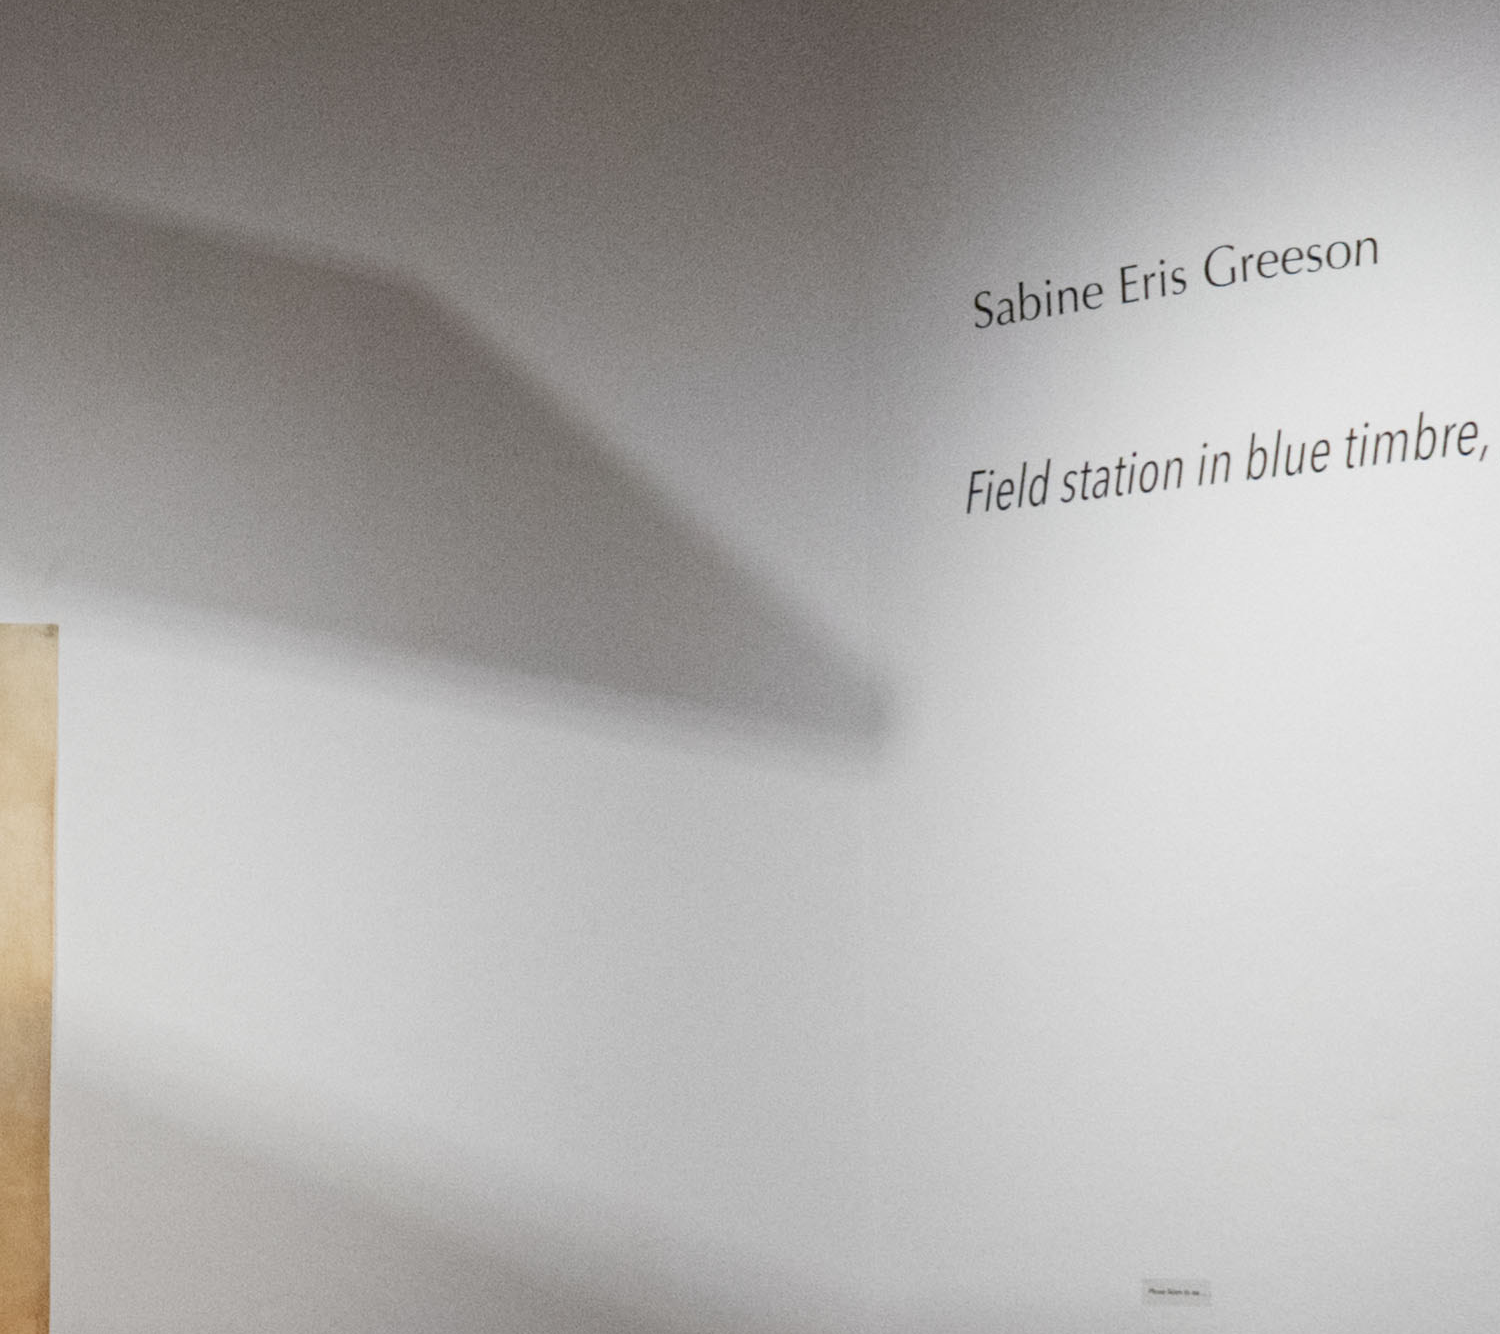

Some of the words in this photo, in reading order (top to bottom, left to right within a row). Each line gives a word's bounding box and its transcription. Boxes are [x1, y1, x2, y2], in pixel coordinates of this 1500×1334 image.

[973, 279, 1104, 330] Sabine
[1119, 258, 1188, 305] Eris
[1203, 236, 1379, 288] Greeson
[966, 457, 1052, 515] Field
[1059, 451, 1184, 504] station
[1197, 442, 1232, 487] in
[1245, 428, 1331, 481] blue
[1344, 410, 1489, 470] timbre,
